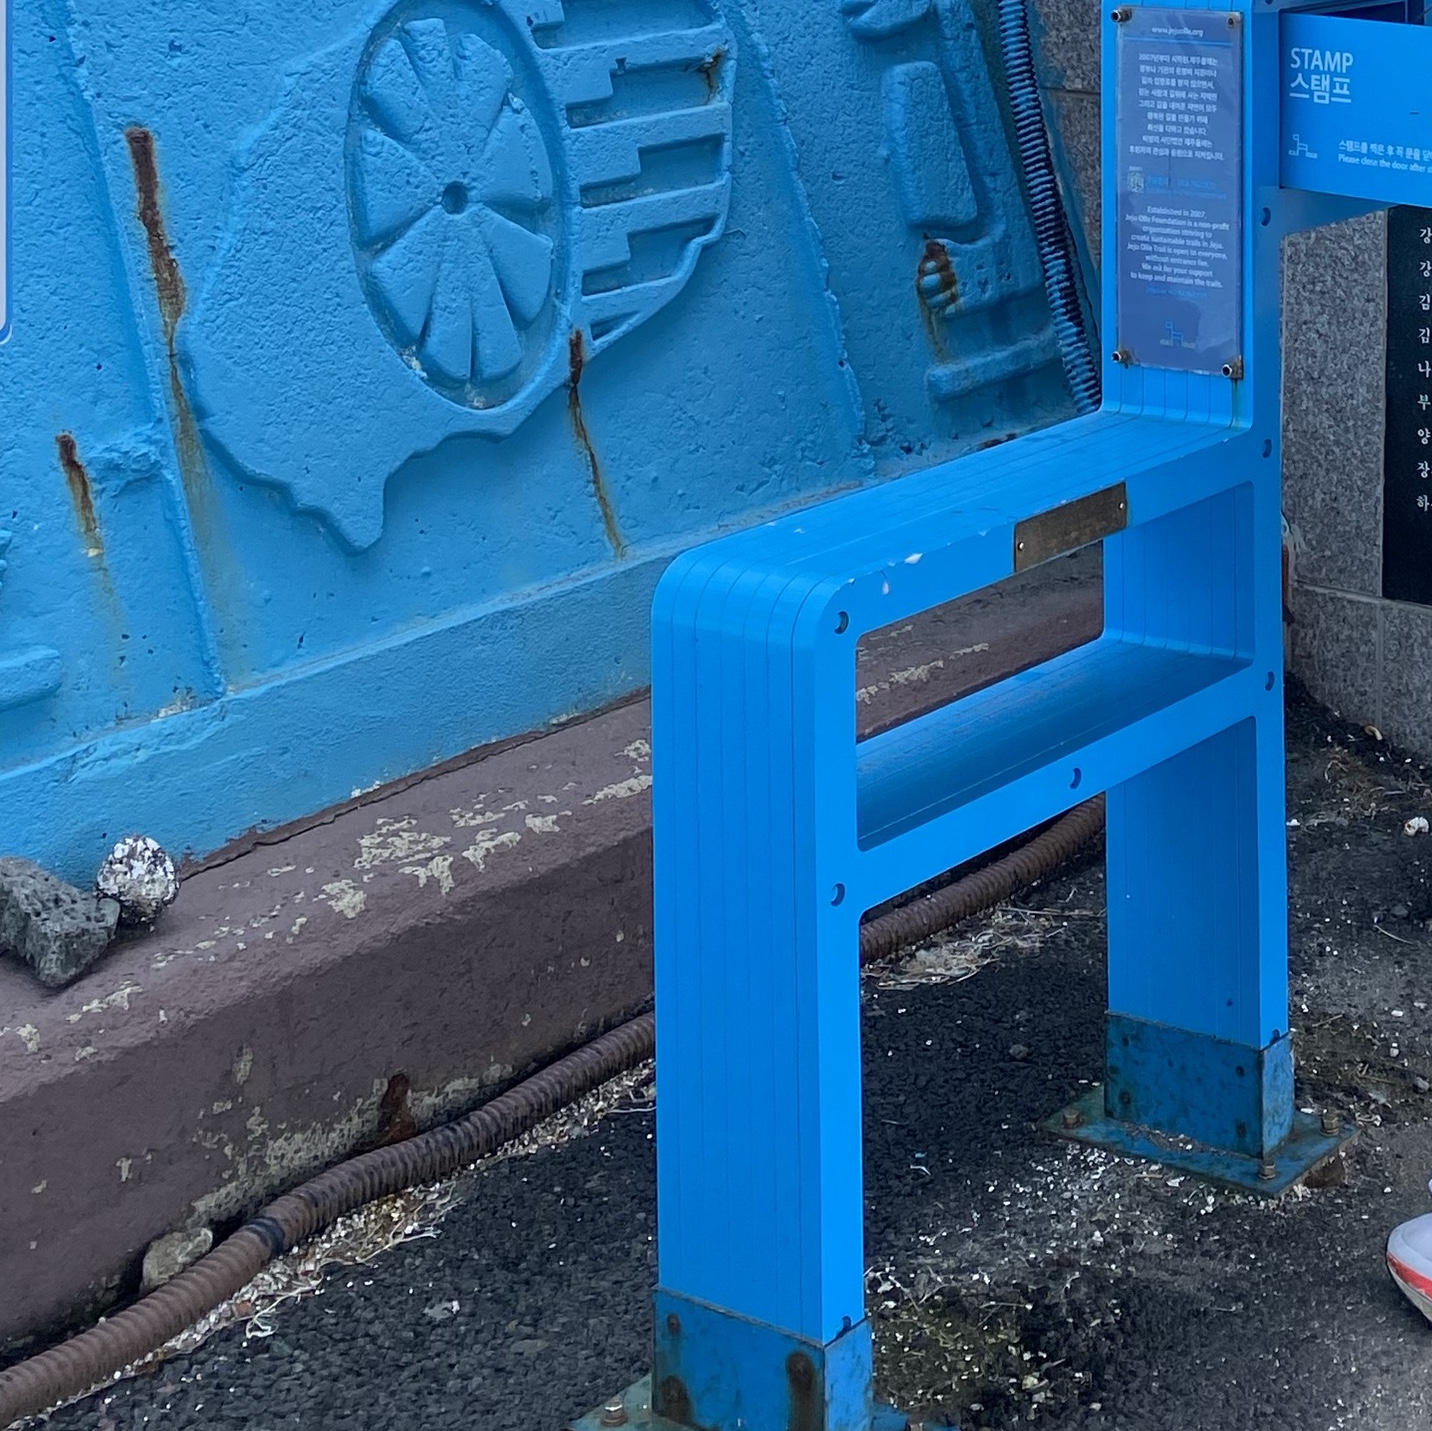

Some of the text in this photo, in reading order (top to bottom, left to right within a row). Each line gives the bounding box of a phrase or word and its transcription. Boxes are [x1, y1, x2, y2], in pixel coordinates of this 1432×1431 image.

[1290, 47, 1354, 73] STAMP
[1289, 72, 1352, 104] 스탬프
[1338, 139, 1368, 154] 스탬프를
[1338, 153, 1360, 165] Please
[1360, 157, 1378, 167] close
[1379, 158, 1391, 168] the
[1391, 160, 1408, 170] door
[1409, 163, 1426, 173] after
